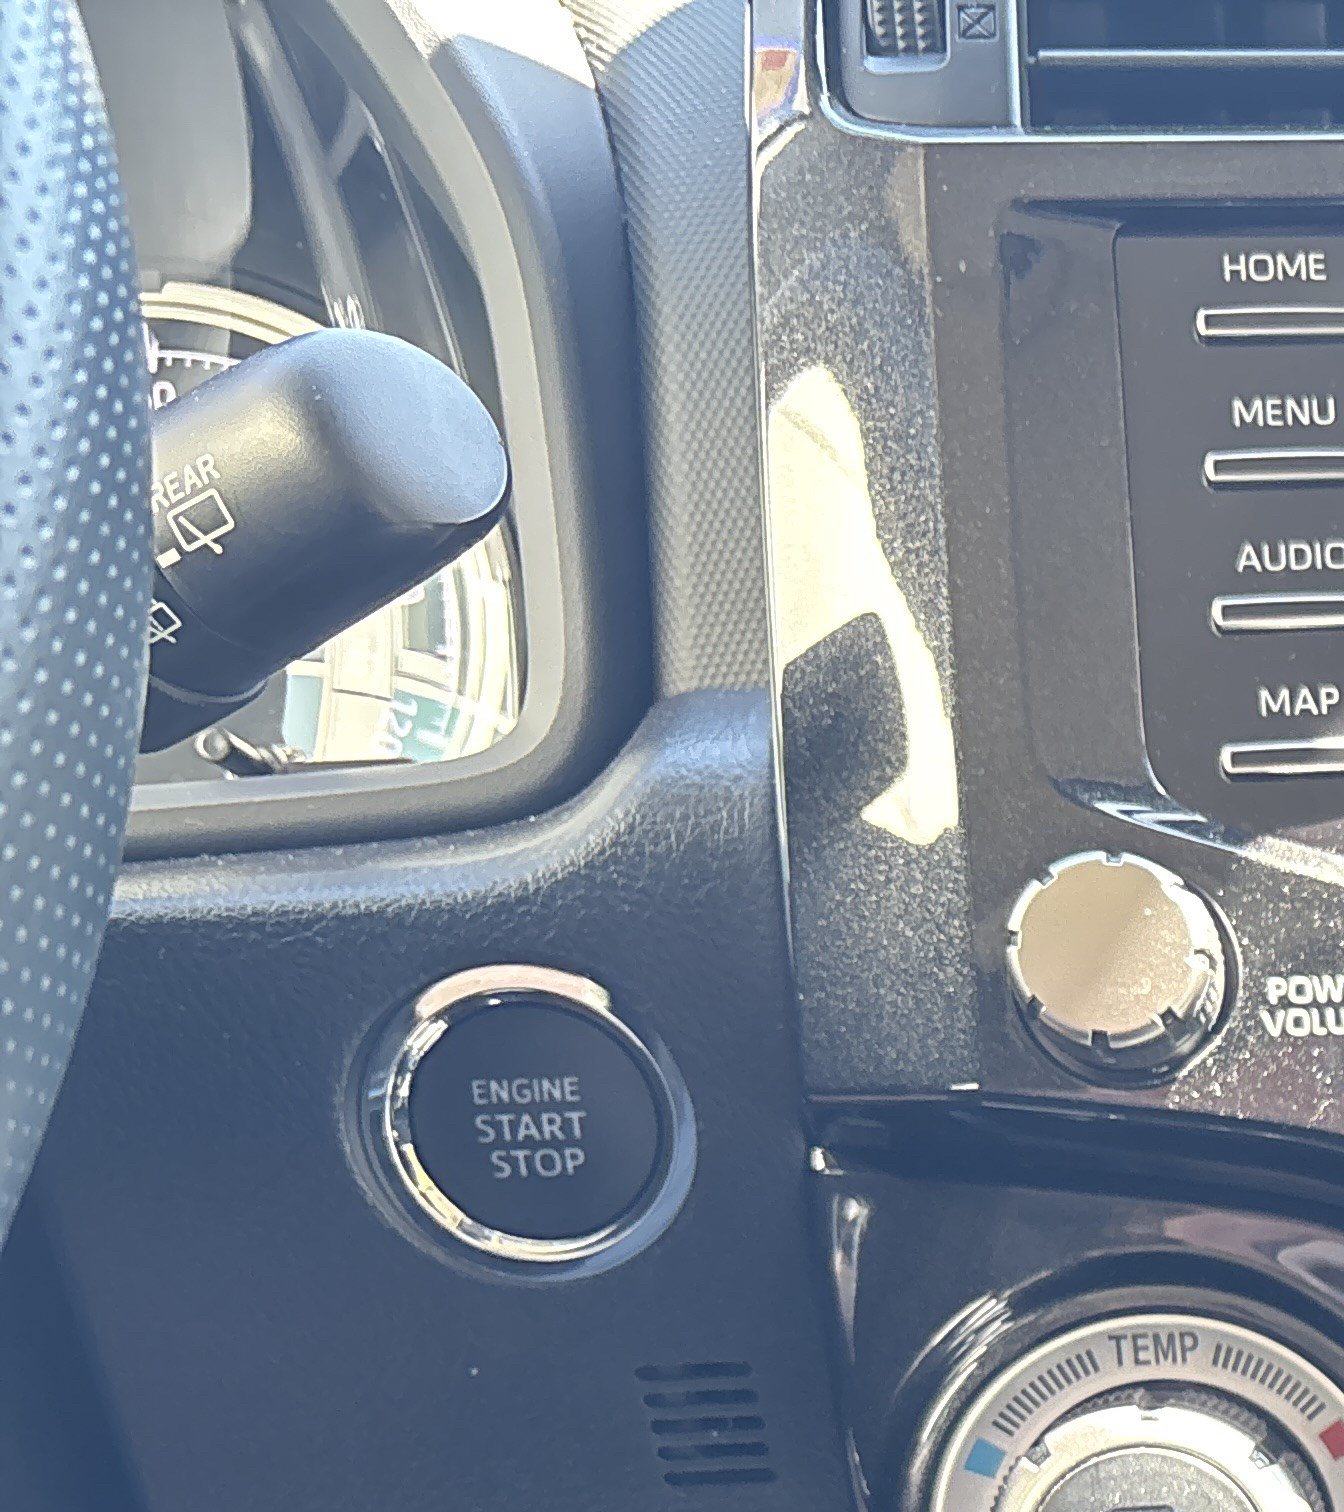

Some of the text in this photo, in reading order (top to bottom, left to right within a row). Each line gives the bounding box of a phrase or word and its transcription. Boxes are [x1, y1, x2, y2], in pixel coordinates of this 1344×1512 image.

[1222, 252, 1328, 282] HOME
[1232, 396, 1337, 428] MENU
[151, 453, 221, 514] REAR
[1259, 686, 1341, 718] MAP
[472, 1076, 581, 1107] ENGINE
[474, 1111, 588, 1144] START
[490, 1147, 587, 1180] STOP
[1108, 1332, 1200, 1368] TEMP
